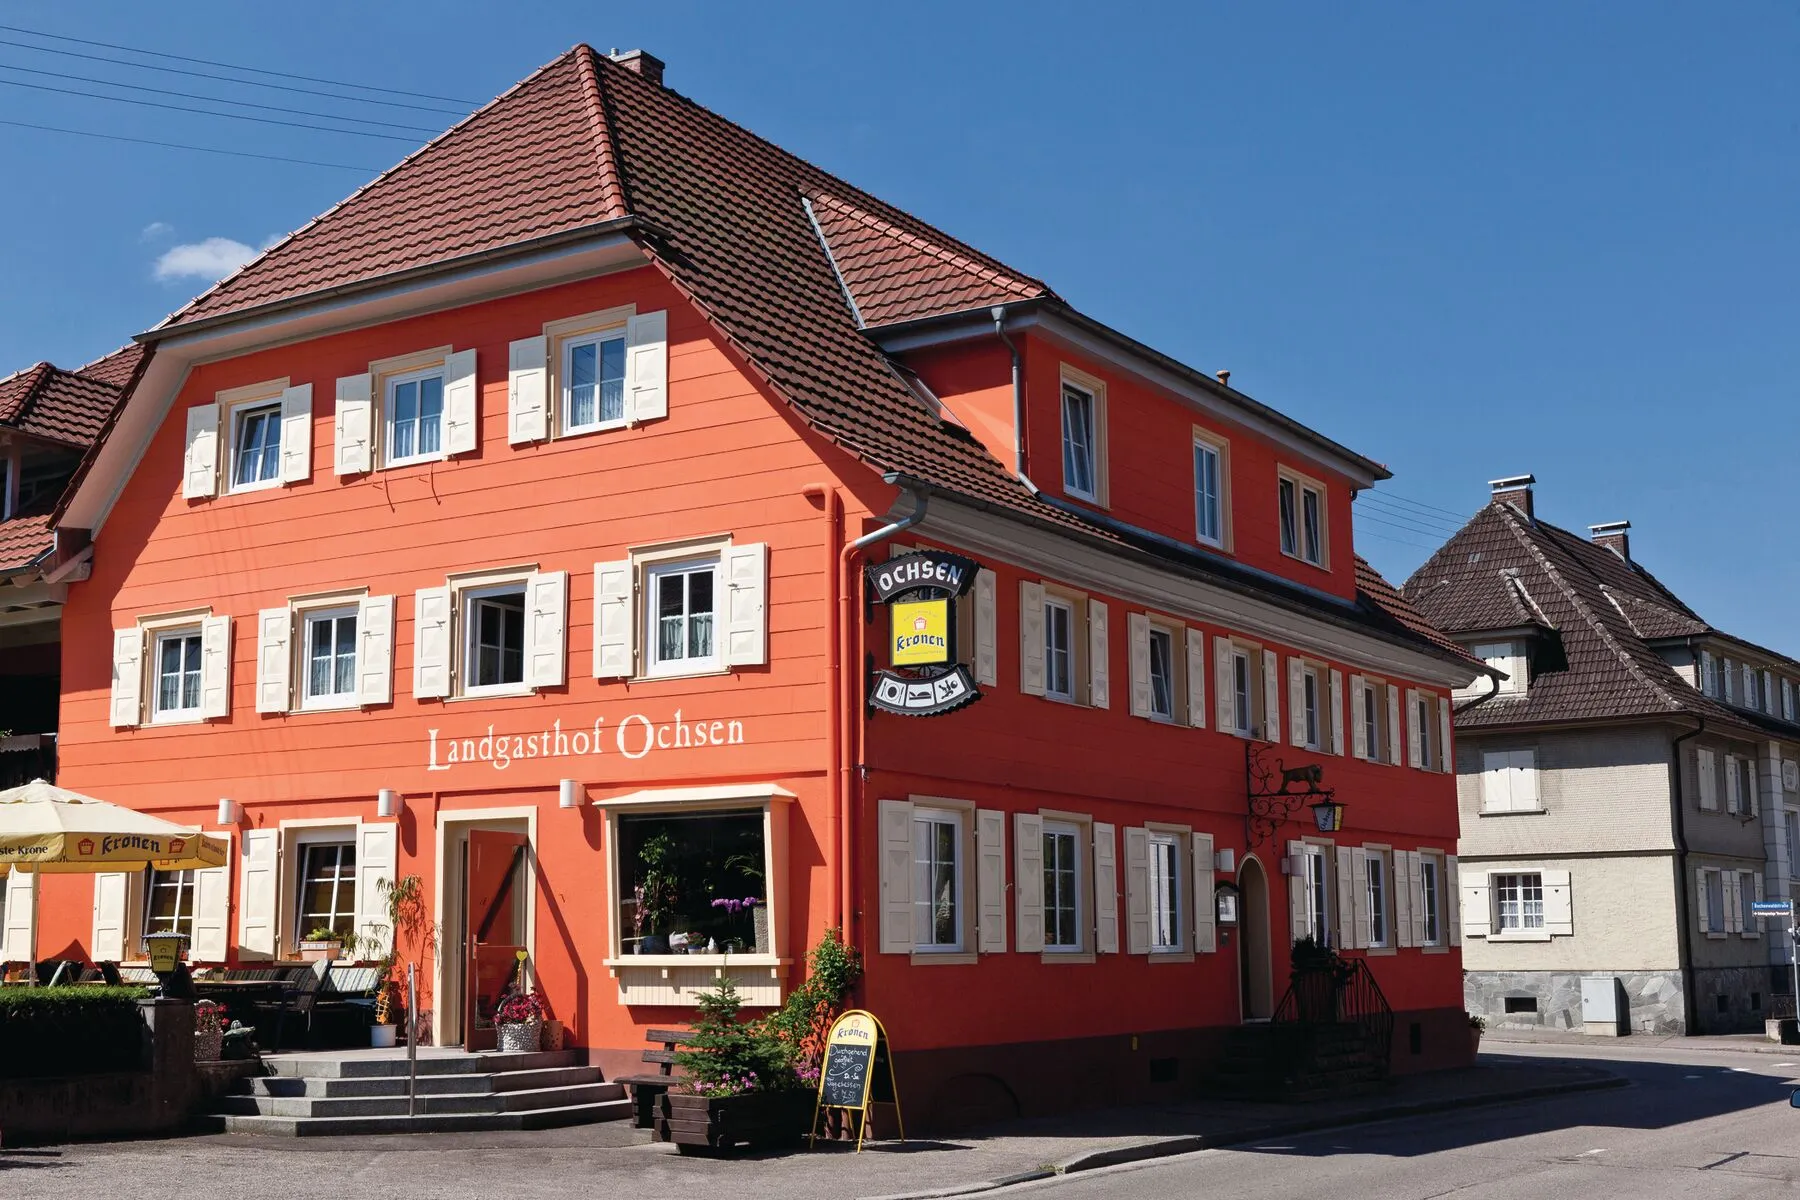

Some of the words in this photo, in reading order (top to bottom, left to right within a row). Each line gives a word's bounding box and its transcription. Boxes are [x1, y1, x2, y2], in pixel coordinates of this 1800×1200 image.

[878, 560, 963, 591] OCHSEN
[896, 634, 945, 652] Kronen
[427, 716, 605, 771] Landgasthof
[616, 708, 745, 760] Ochsen
[18, 844, 49, 856] Krone
[101, 835, 161, 856] Kronen
[837, 1027, 869, 1040] Kronen
